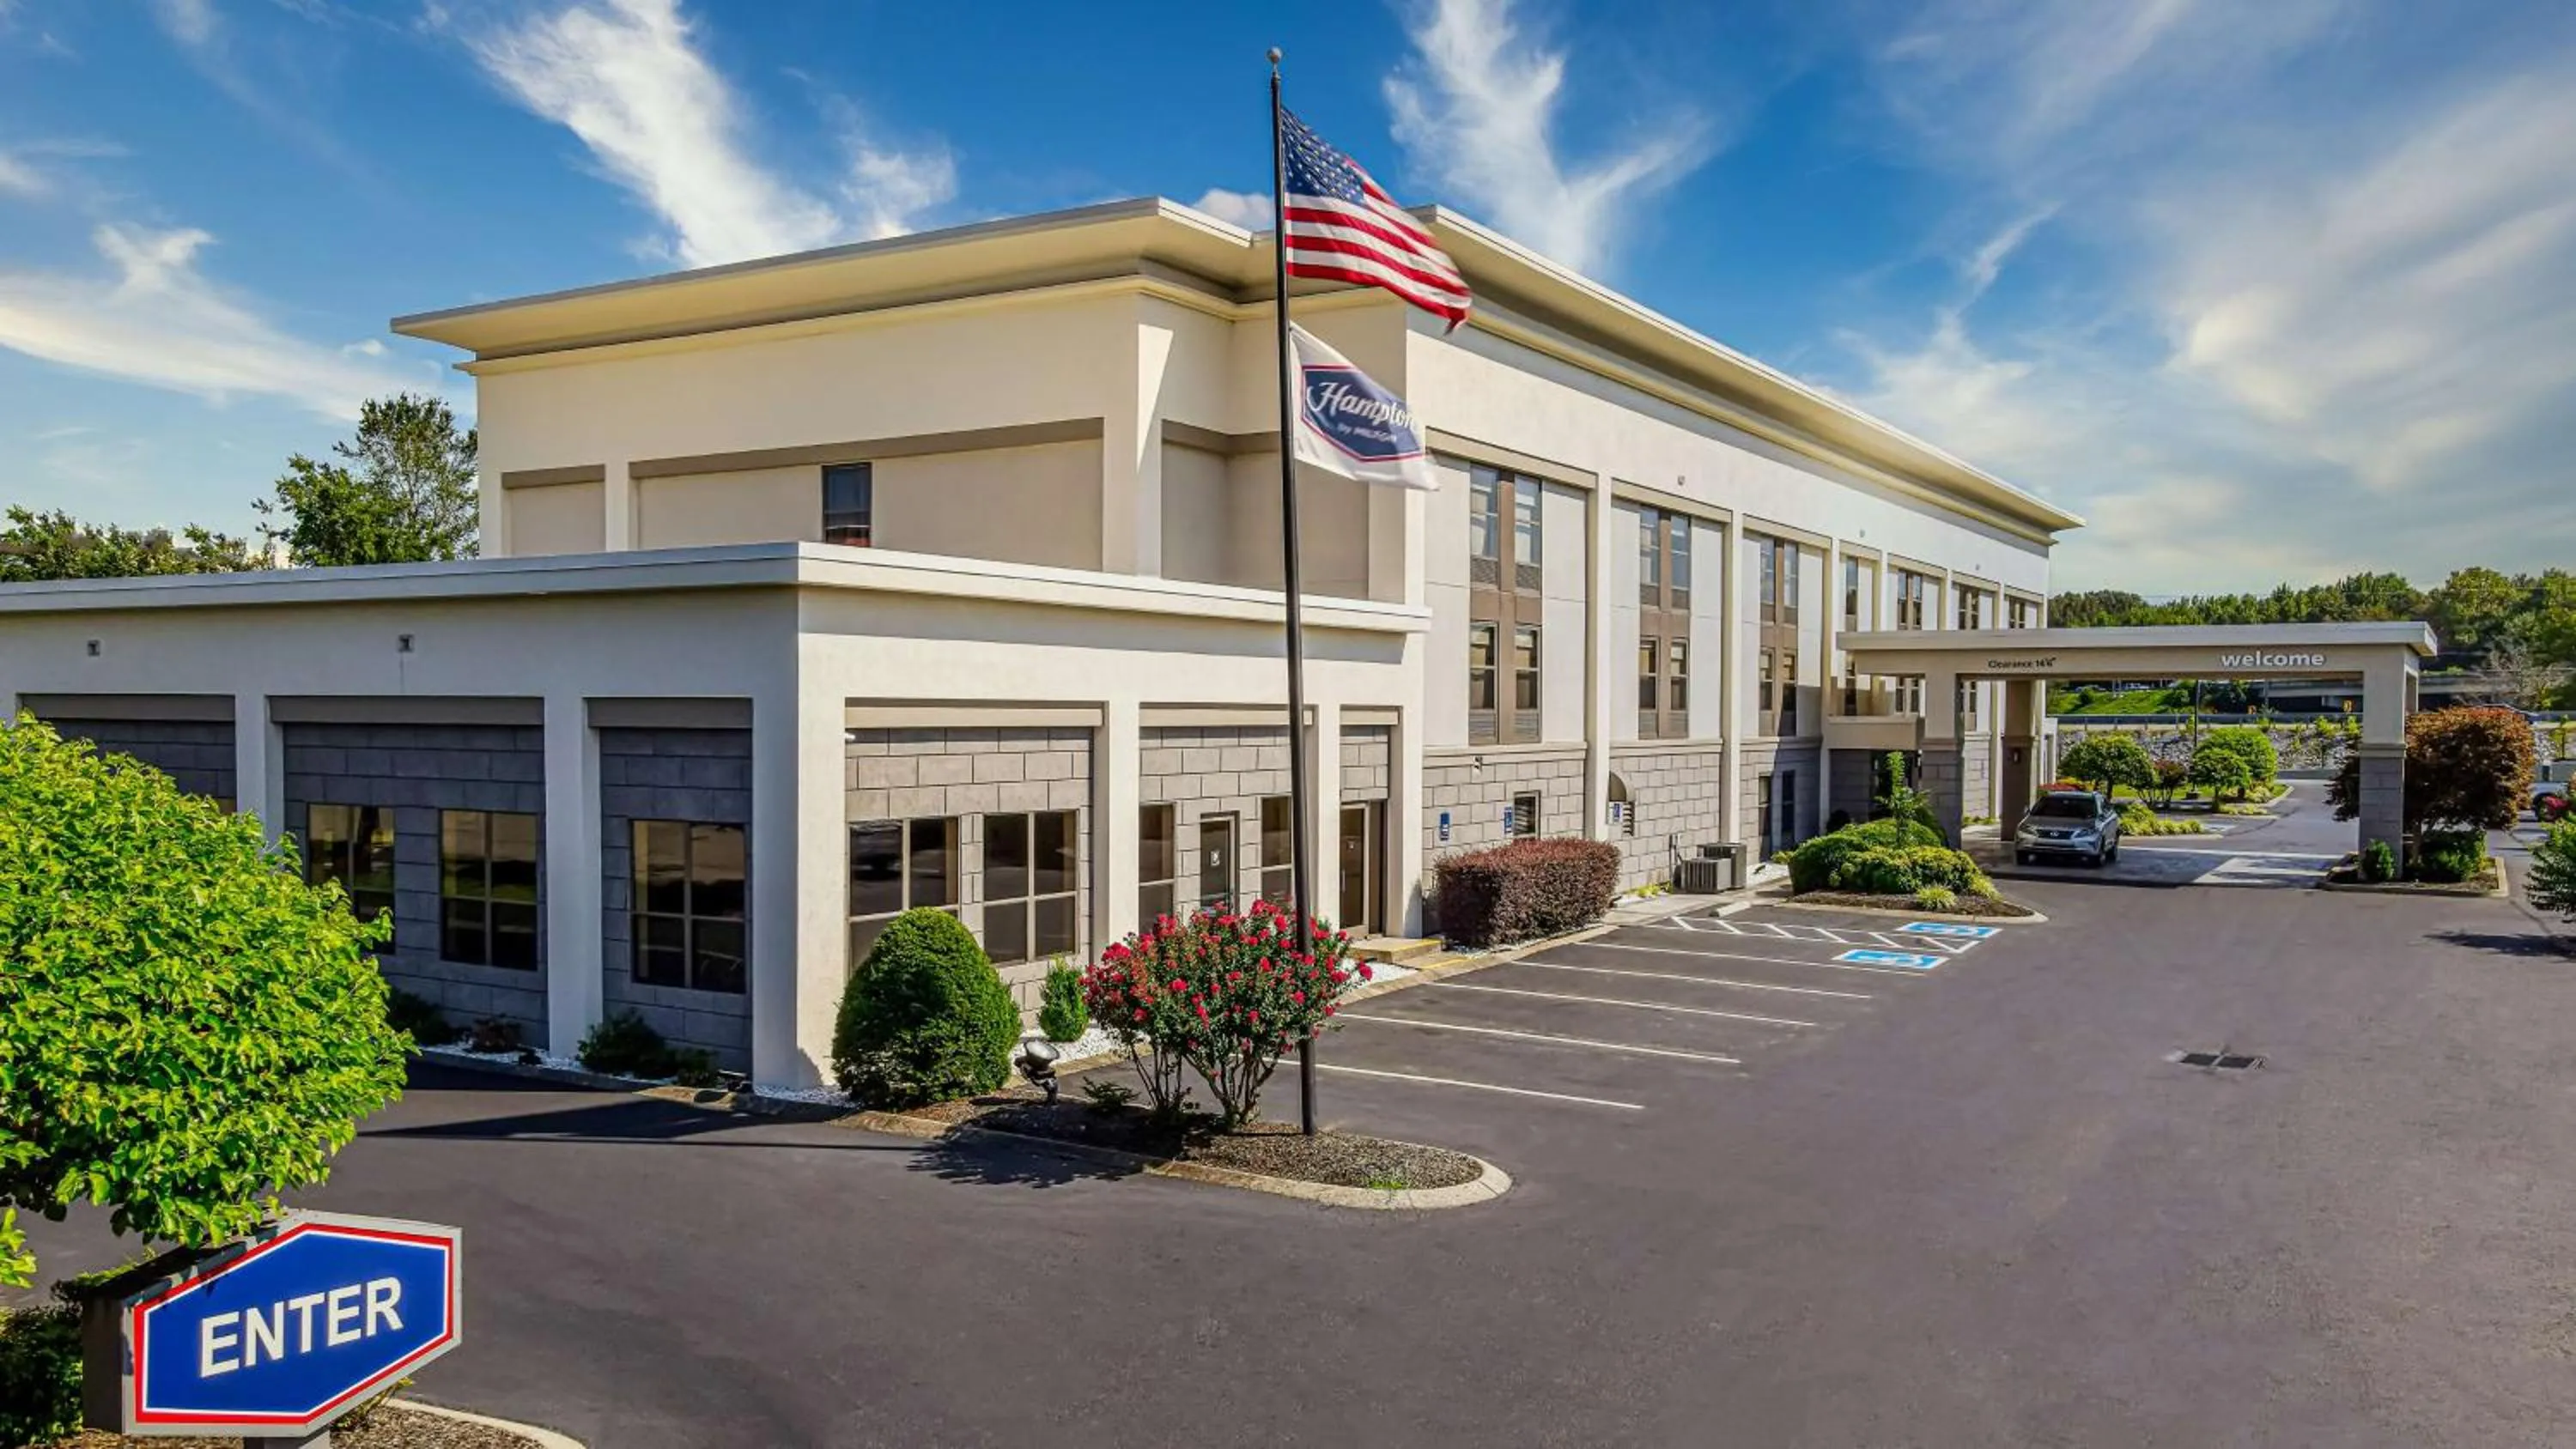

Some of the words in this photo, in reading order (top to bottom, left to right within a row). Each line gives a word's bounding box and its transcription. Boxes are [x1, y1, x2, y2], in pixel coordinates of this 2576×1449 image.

[1306, 382, 1415, 427] Hampton
[2221, 651, 2324, 666] welcome
[200, 1276, 404, 1378] ENTER
